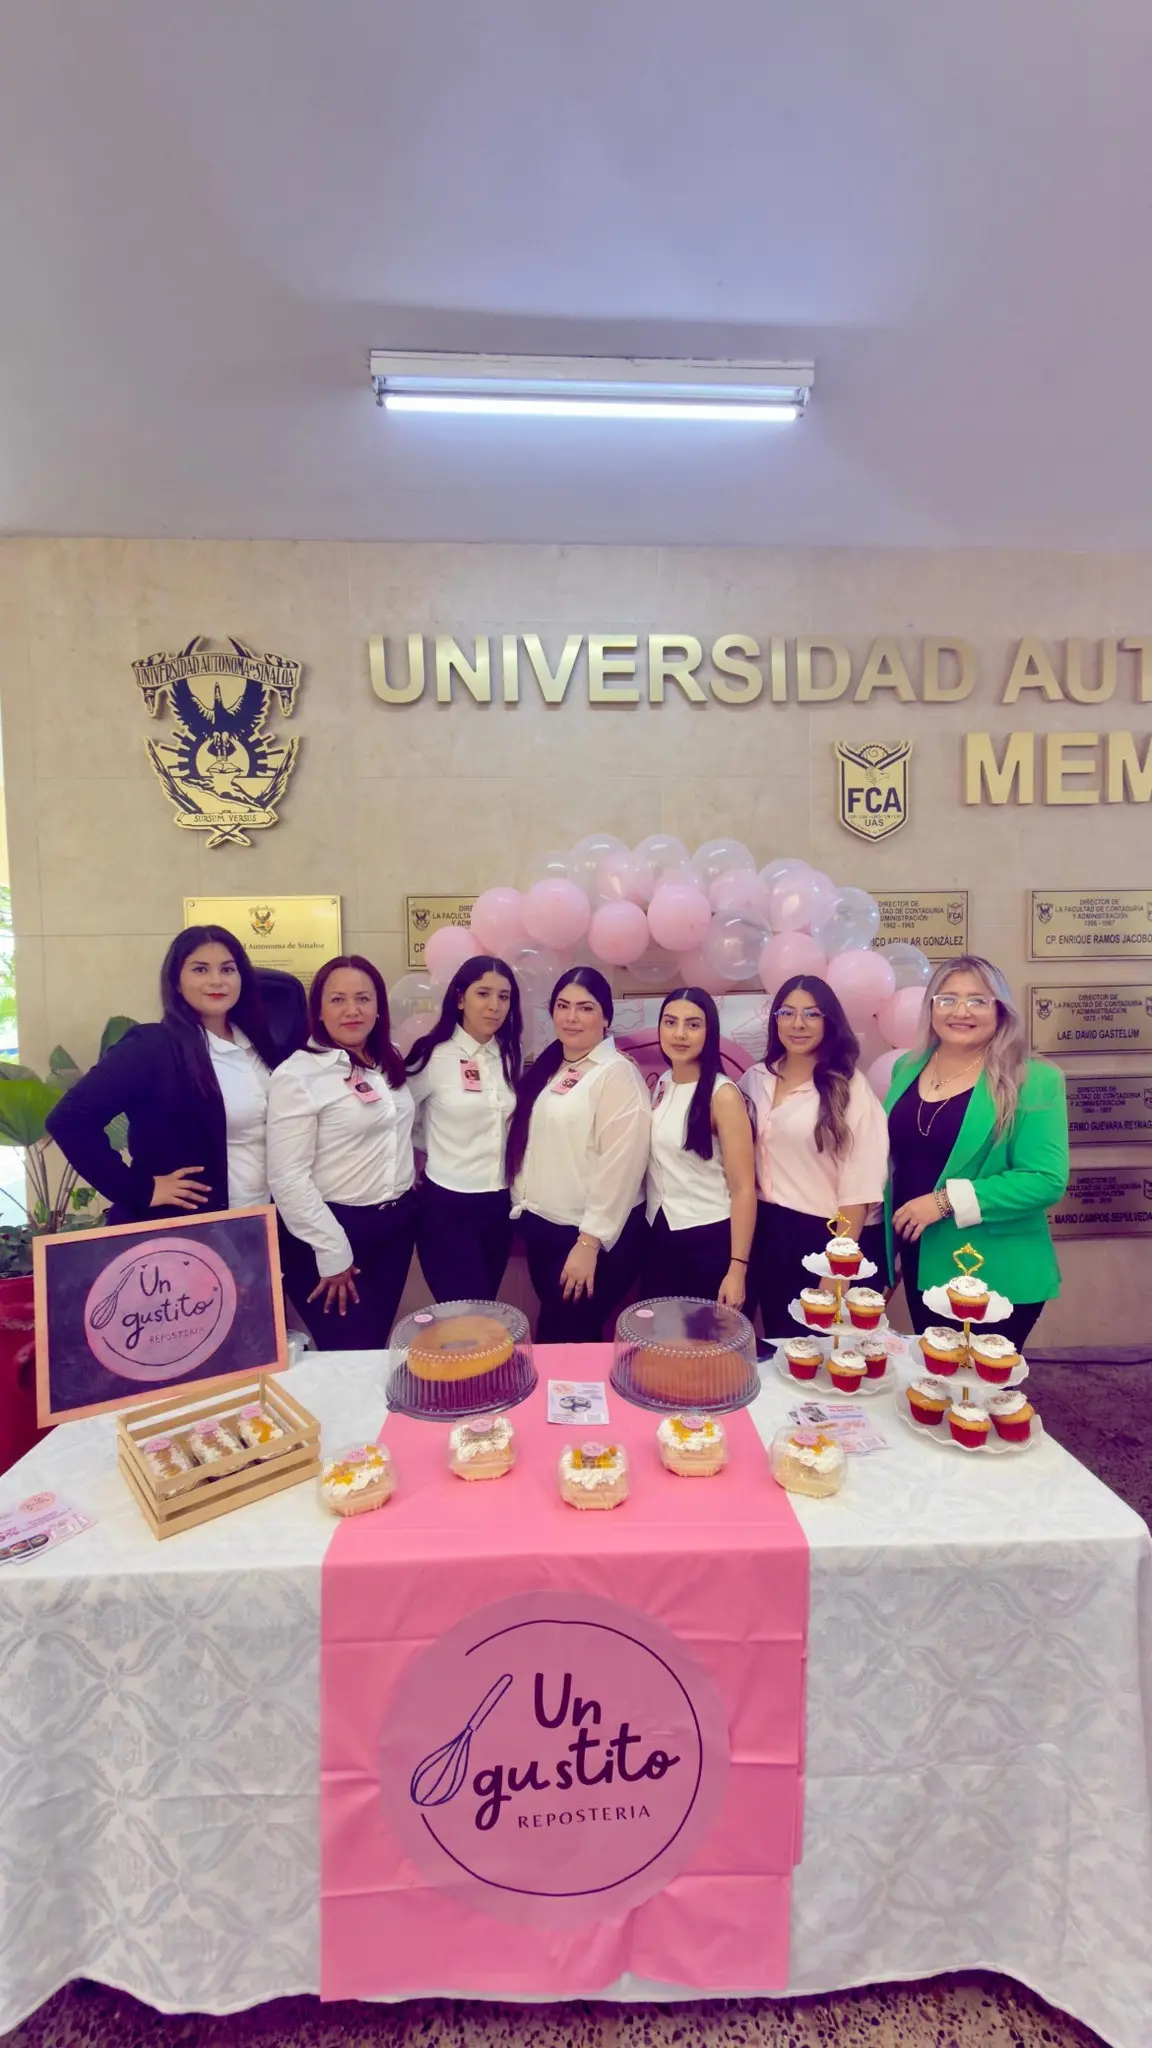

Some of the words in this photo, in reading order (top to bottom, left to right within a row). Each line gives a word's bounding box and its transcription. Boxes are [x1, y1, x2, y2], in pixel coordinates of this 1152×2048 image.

[137, 657, 200, 685] UNIVERSIDAD
[201, 654, 251, 677] AUTONOMA
[253, 662, 294, 685] SINALOA
[367, 633, 979, 706] UNIVERSIDAD
[1001, 635, 1152, 705] AUT
[964, 730, 1152, 806] MEM
[847, 786, 902, 814] FCA
[194, 814, 225, 823] SURSUM
[228, 814, 257, 822] VERSUS
[864, 818, 884, 827] UAS
[298, 941, 325, 949] Sinaloa
[922, 934, 964, 946] GONZÁLEZ
[1058, 935, 1092, 945] ENRIQUE
[1093, 934, 1120, 944] RAMOS
[1075, 1030, 1097, 1039] DAVID
[1098, 1028, 1140, 1039] GASTELUM
[1090, 1121, 1122, 1131] GUEVARA
[140, 1266, 171, 1296] Un
[122, 1294, 214, 1349] gustito
[534, 1672, 602, 1729] Un
[472, 1722, 681, 1831] gustito
[517, 1804, 652, 1829] REPOSTERIA
